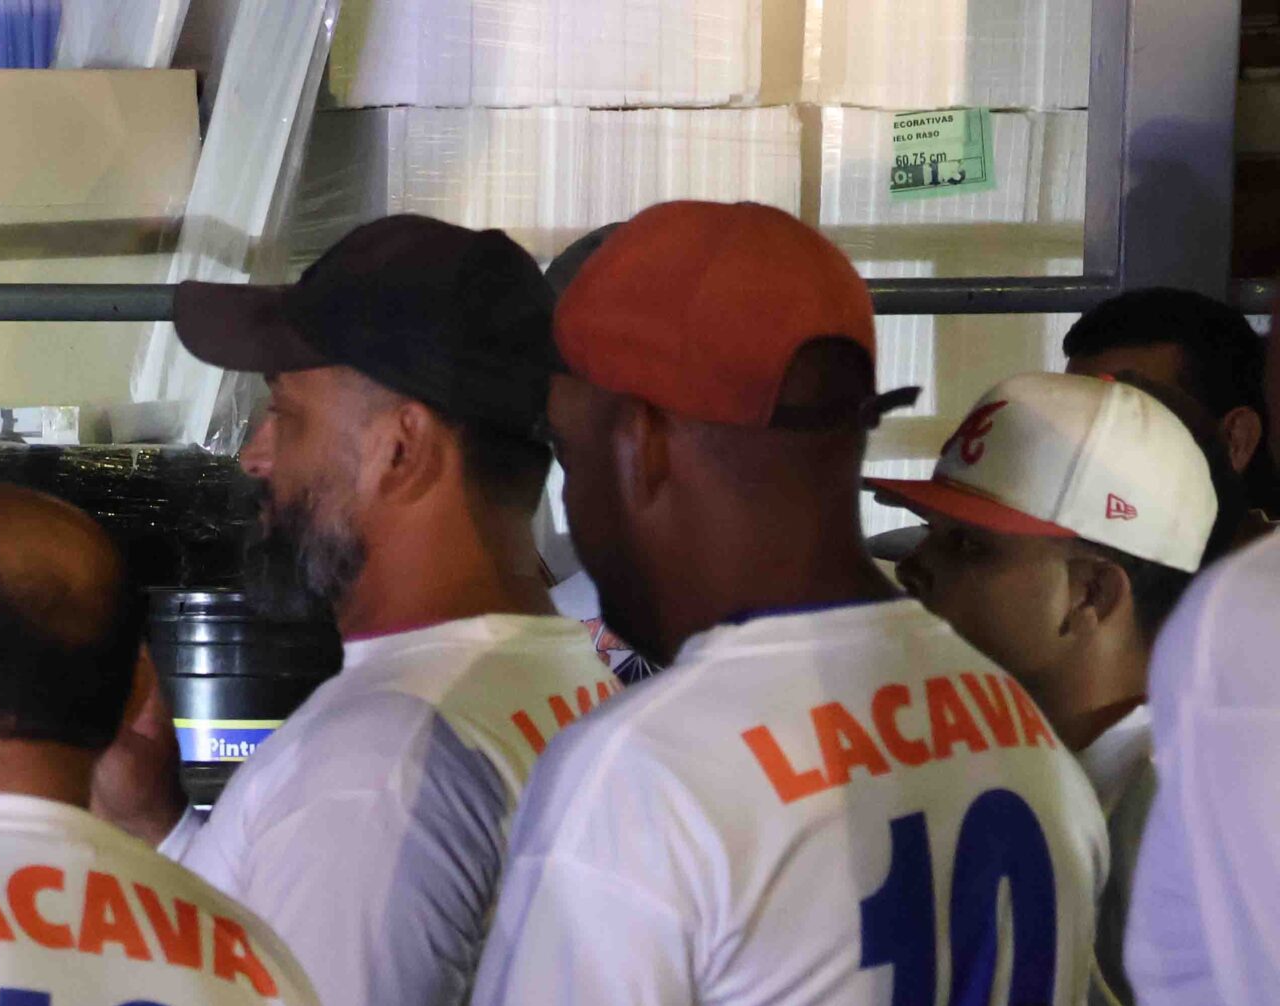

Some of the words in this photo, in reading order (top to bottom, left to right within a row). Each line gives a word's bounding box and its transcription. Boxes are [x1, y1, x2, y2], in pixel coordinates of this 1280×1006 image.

[915, 130, 940, 141] RASO
[929, 152, 947, 163] cm
[741, 670, 1057, 806] LACAVA
